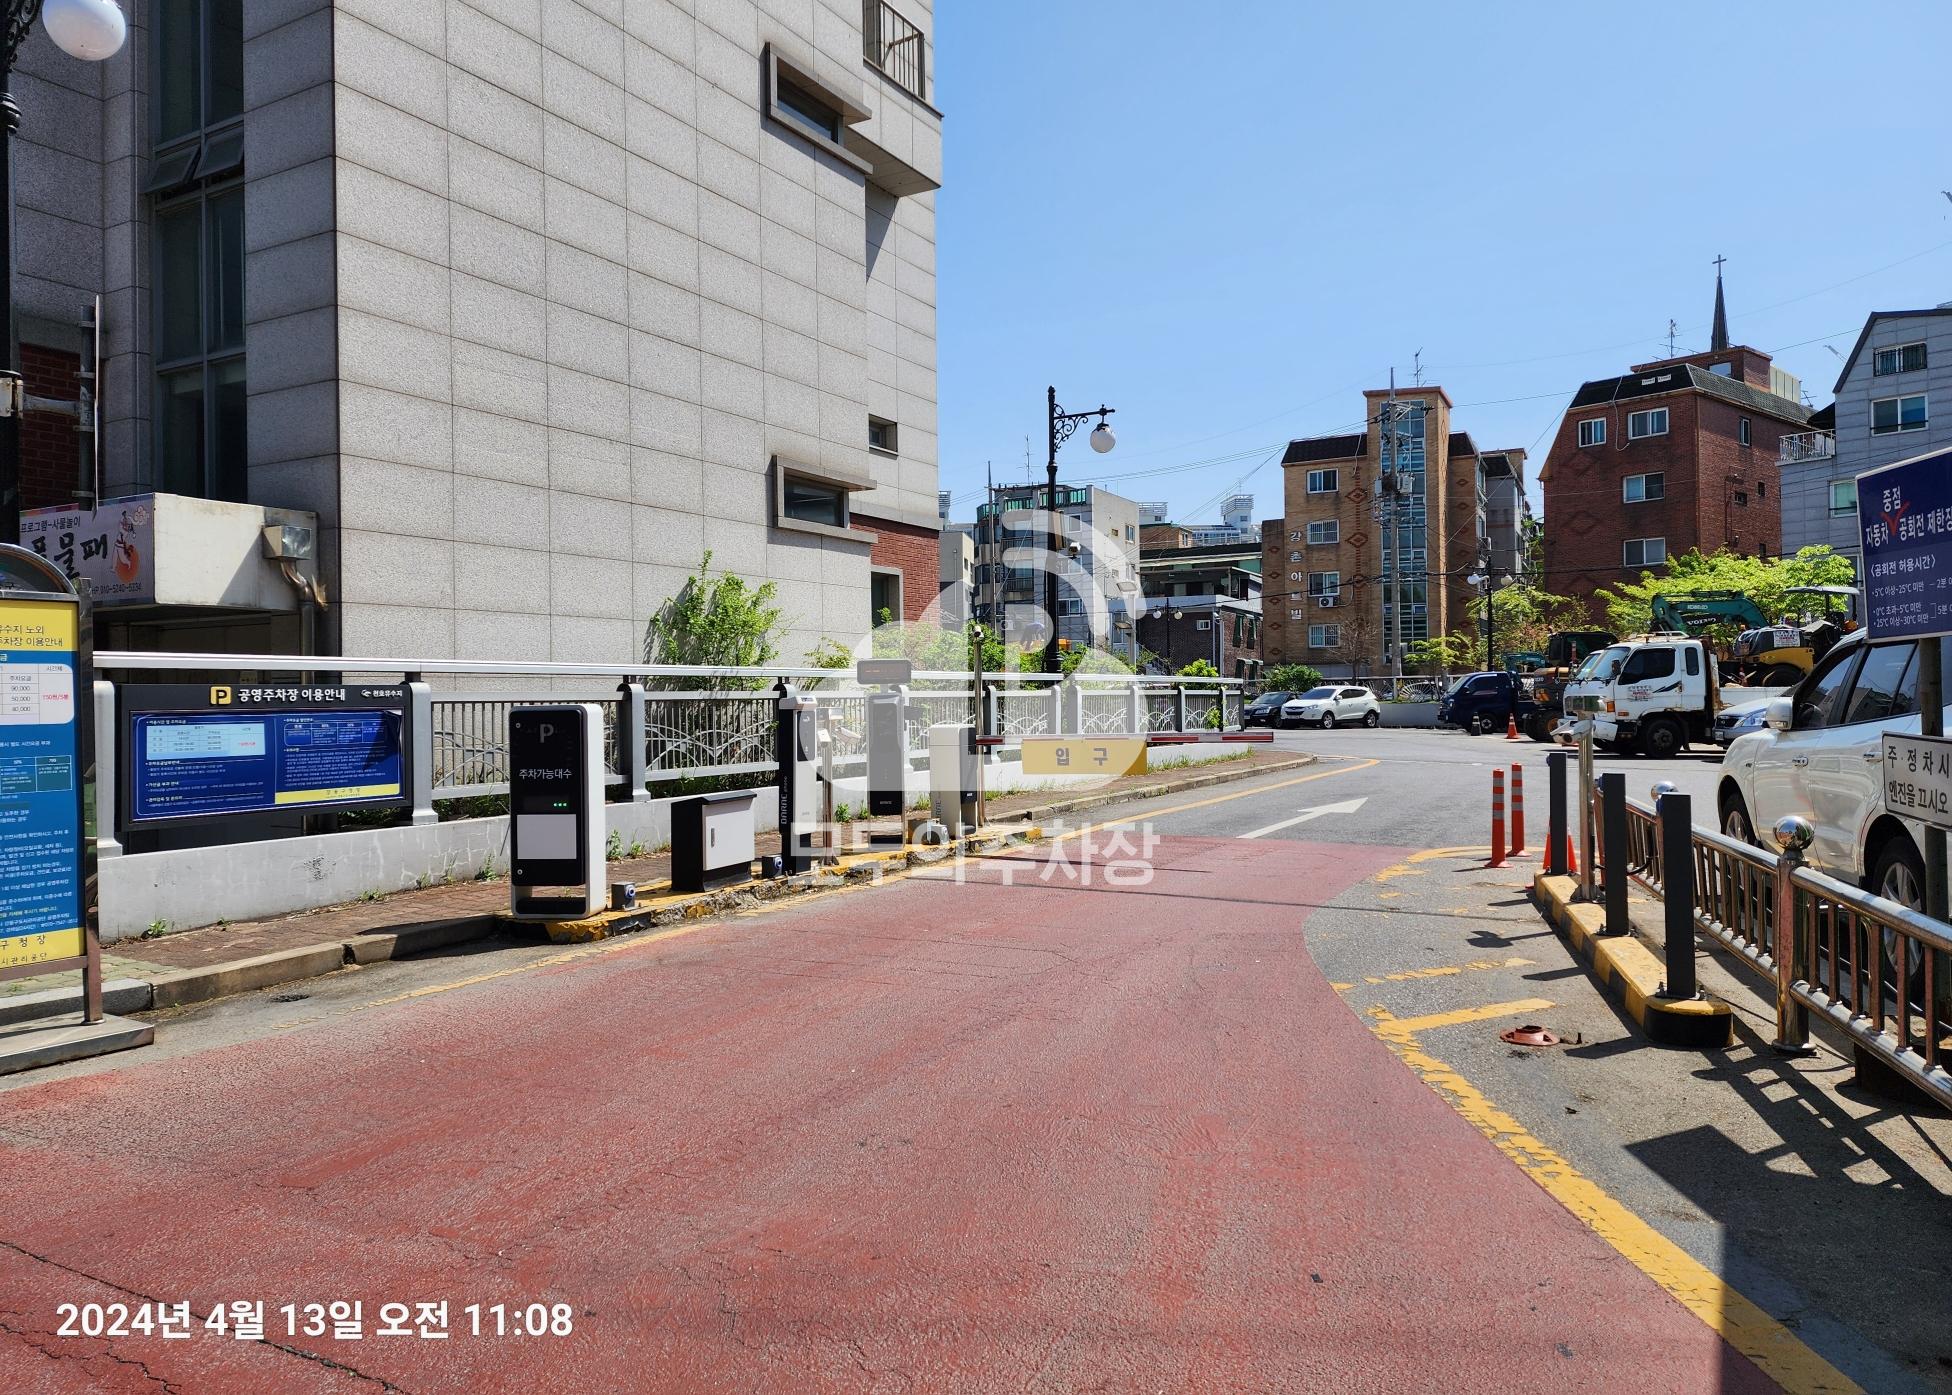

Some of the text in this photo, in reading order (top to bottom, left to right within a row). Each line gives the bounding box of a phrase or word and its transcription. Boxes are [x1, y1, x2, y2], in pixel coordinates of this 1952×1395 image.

[1883, 486, 1901, 513] 중점
[1866, 521, 1889, 548] 자동차
[1899, 513, 1925, 541] 공회전
[26, 625, 45, 634] 노외
[26, 638, 64, 646] 이용안내
[238, 688, 298, 702] 공영주차장
[301, 688, 346, 702] 이용안내
[518, 768, 573, 780] 주차가능대수
[1888, 780, 1949, 814] 엔진을 끄시오
